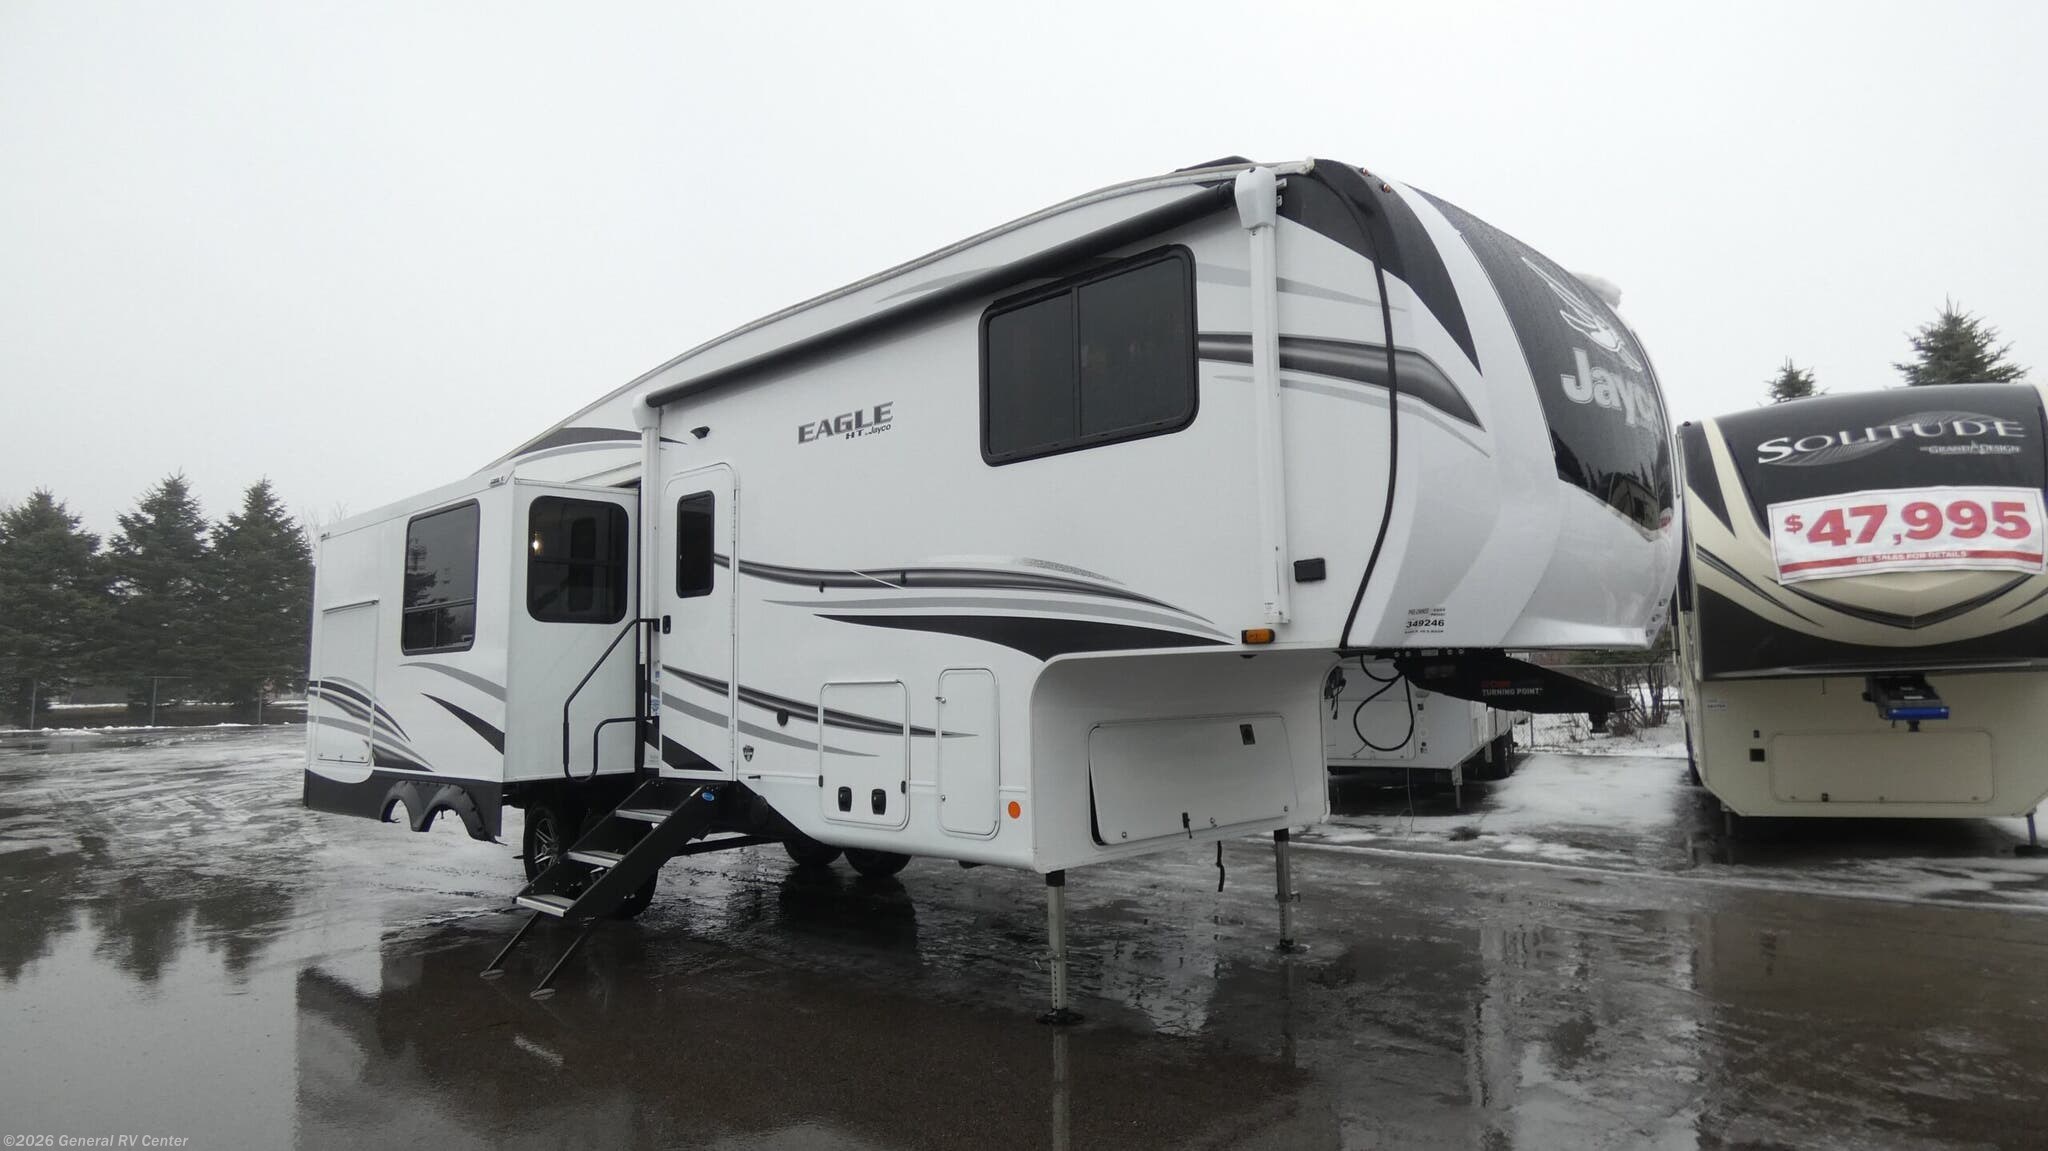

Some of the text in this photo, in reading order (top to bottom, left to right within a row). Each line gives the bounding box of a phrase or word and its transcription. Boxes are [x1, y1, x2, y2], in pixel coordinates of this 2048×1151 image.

[798, 401, 893, 444] EAGLE
[846, 429, 864, 440] HT
[871, 424, 891, 435] Jayco
[1758, 421, 2026, 464] SOLITUDE
[1928, 444, 2020, 455] GRAND DESIGN
[1784, 500, 2032, 547] $47,995
[1857, 556, 1873, 564] SEE
[1907, 551, 1926, 560] FOR
[1928, 548, 1967, 559] DETAILS
[1406, 620, 1445, 628] 349246
[1482, 688, 1516, 696] TURNING
